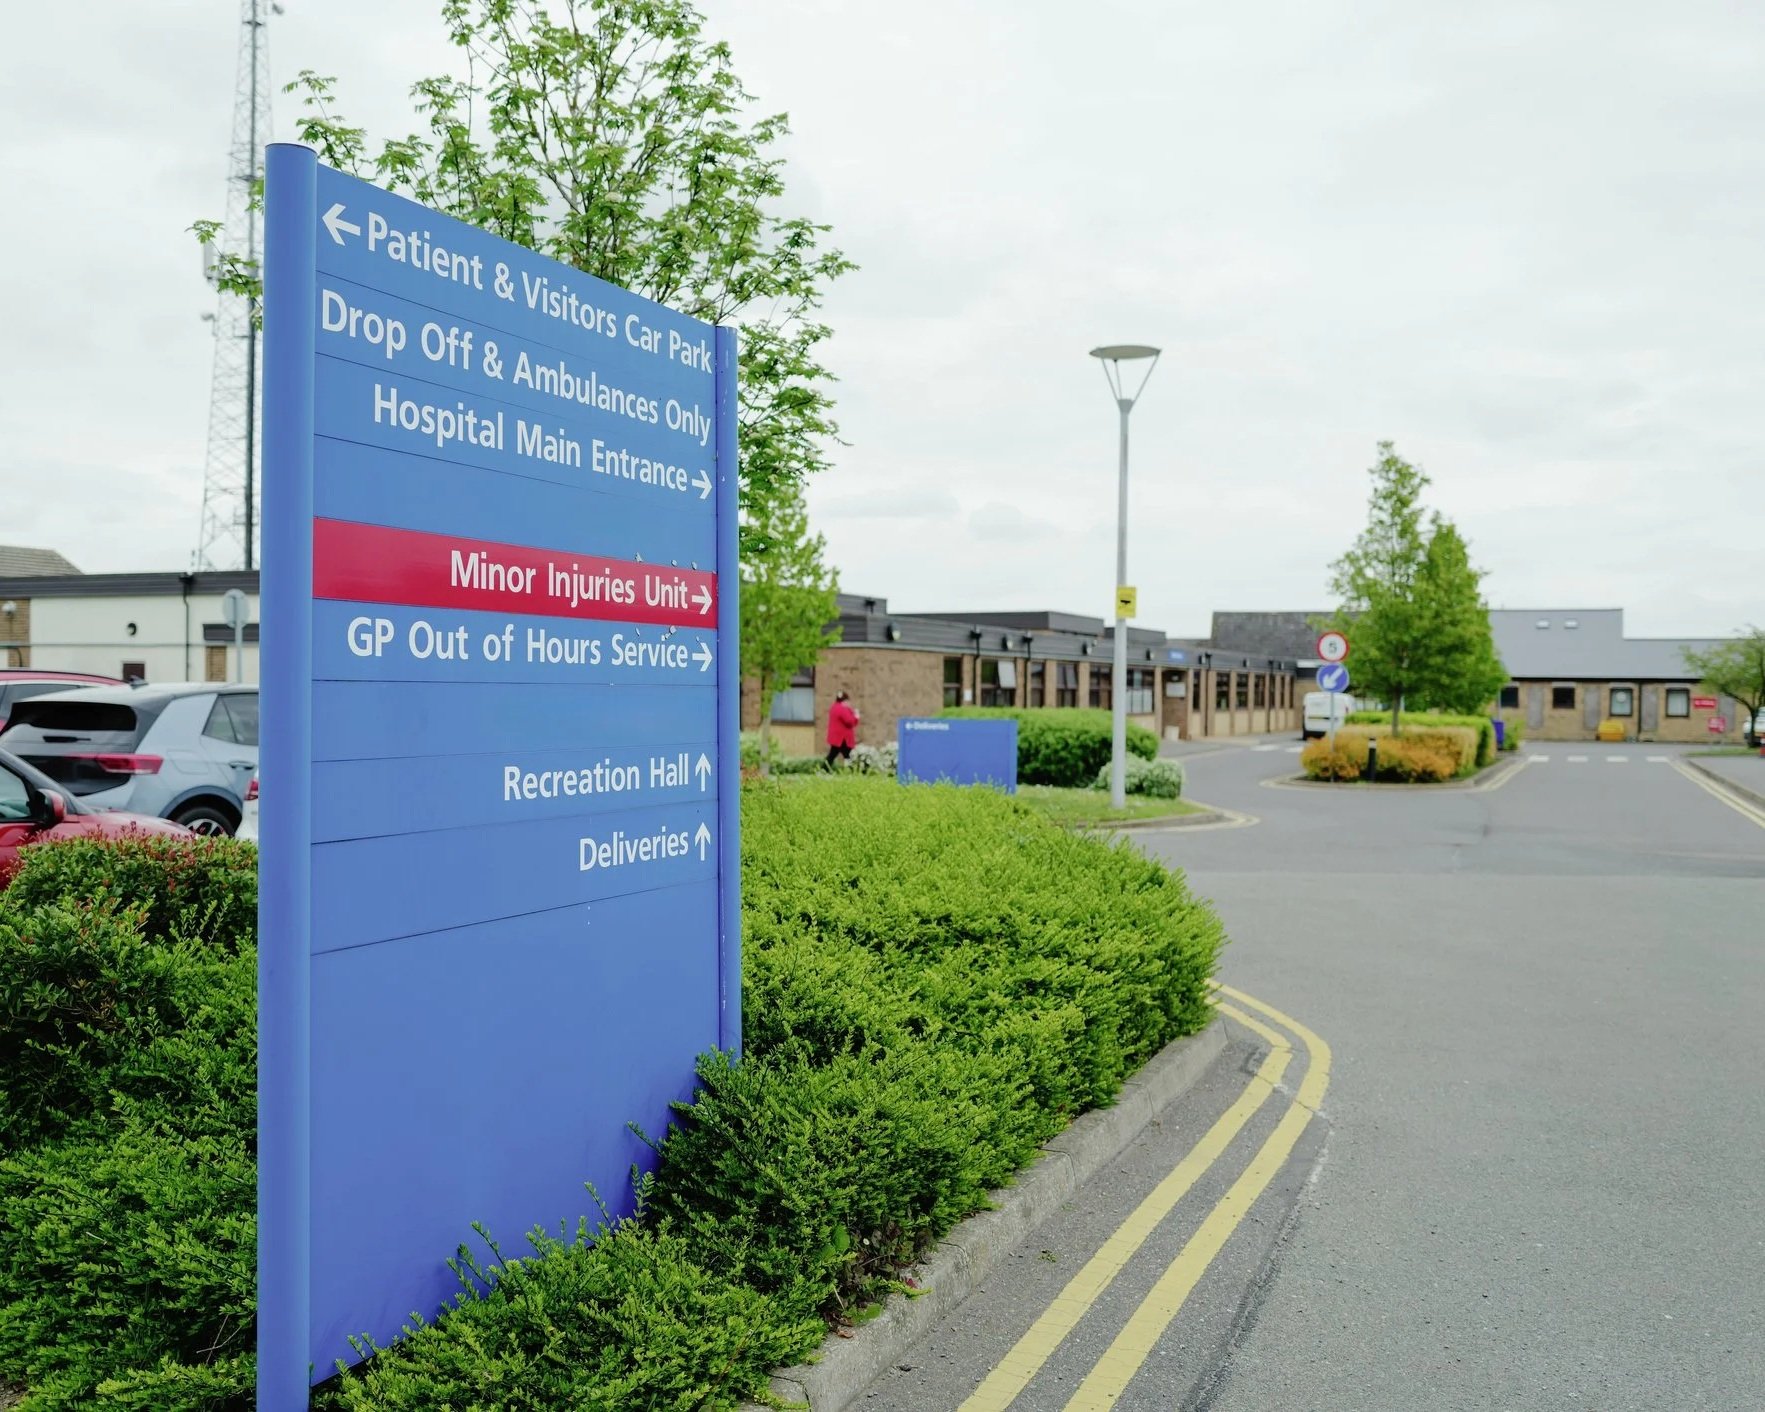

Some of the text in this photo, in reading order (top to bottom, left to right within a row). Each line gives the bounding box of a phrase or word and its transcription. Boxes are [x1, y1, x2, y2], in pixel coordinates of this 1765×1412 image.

[368, 212, 712, 374] Patient & Visitors Car Park
[322, 289, 711, 447] Drop Off & Ambulances Only
[374, 383, 688, 492] Hospital Main Entrance
[451, 550, 688, 609] Minor Injuries Unit
[347, 616, 688, 668] GP Out of Hours Service
[1327, 640, 1338, 654] 5
[504, 753, 689, 801] Recreation Hall
[579, 826, 689, 871] Deliveries
